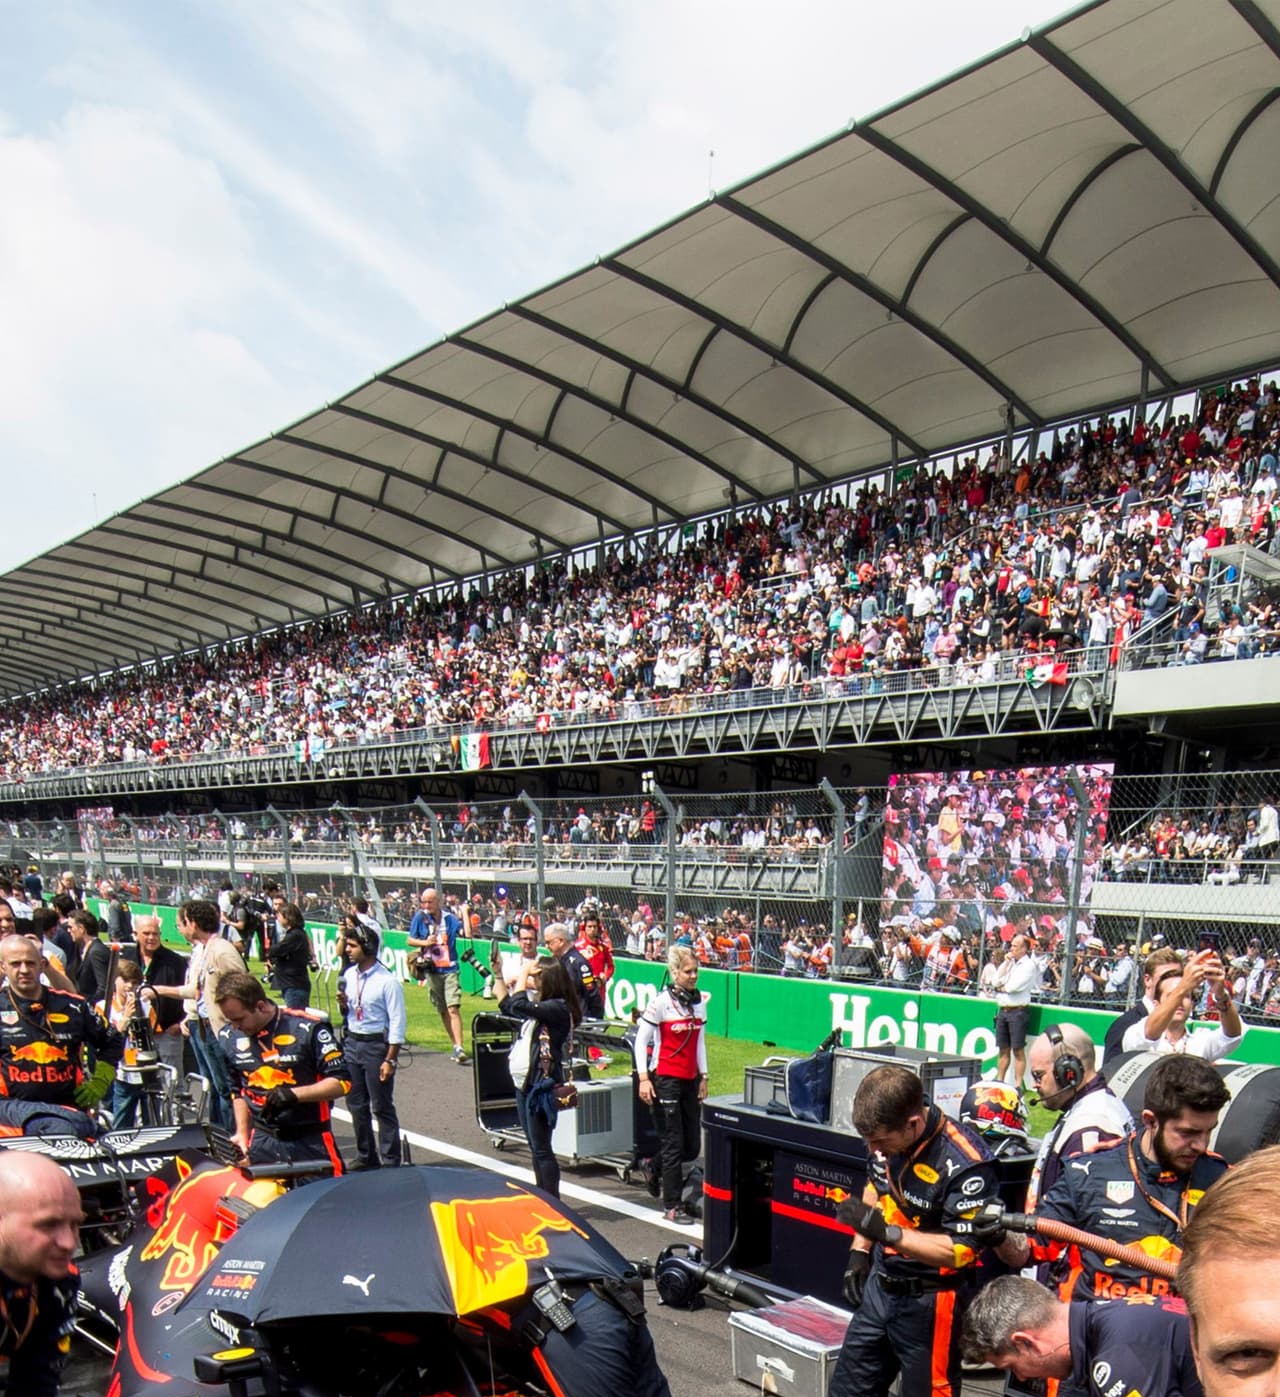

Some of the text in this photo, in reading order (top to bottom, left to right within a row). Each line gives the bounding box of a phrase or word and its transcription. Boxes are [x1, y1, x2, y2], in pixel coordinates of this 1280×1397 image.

[8, 1065, 43, 1083] Red
[794, 1162, 854, 1185] ASTON MARTIN
[206, 1288, 250, 1300] RACING
[1094, 1271, 1148, 1299] Red
